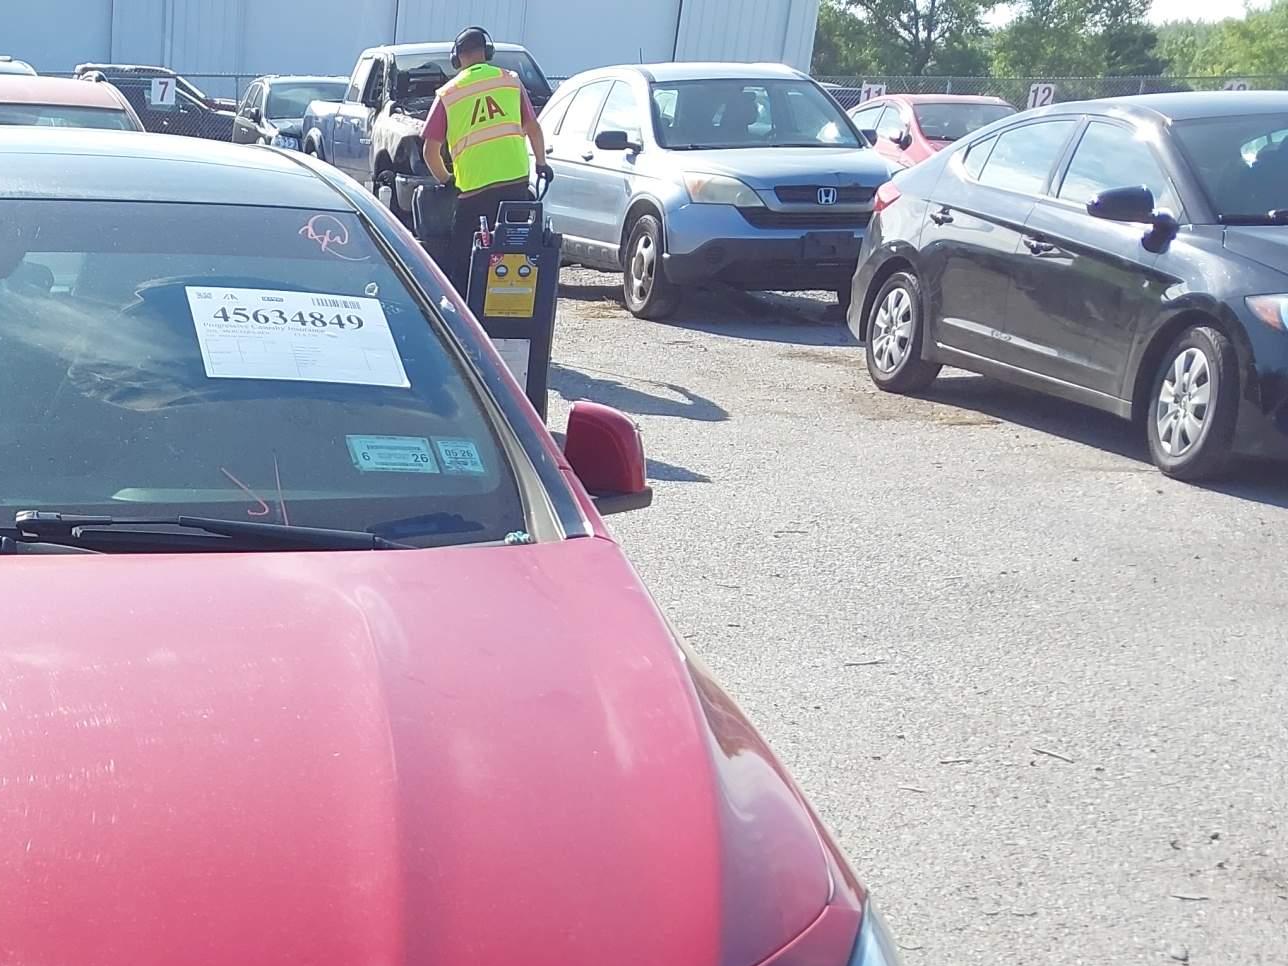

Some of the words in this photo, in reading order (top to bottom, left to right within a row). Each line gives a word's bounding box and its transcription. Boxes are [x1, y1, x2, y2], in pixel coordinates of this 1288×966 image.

[158, 81, 168, 102] 7
[1031, 86, 1052, 108] 12
[213, 306, 364, 330] 45634849
[361, 452, 370, 461] 6
[412, 453, 429, 463] 26
